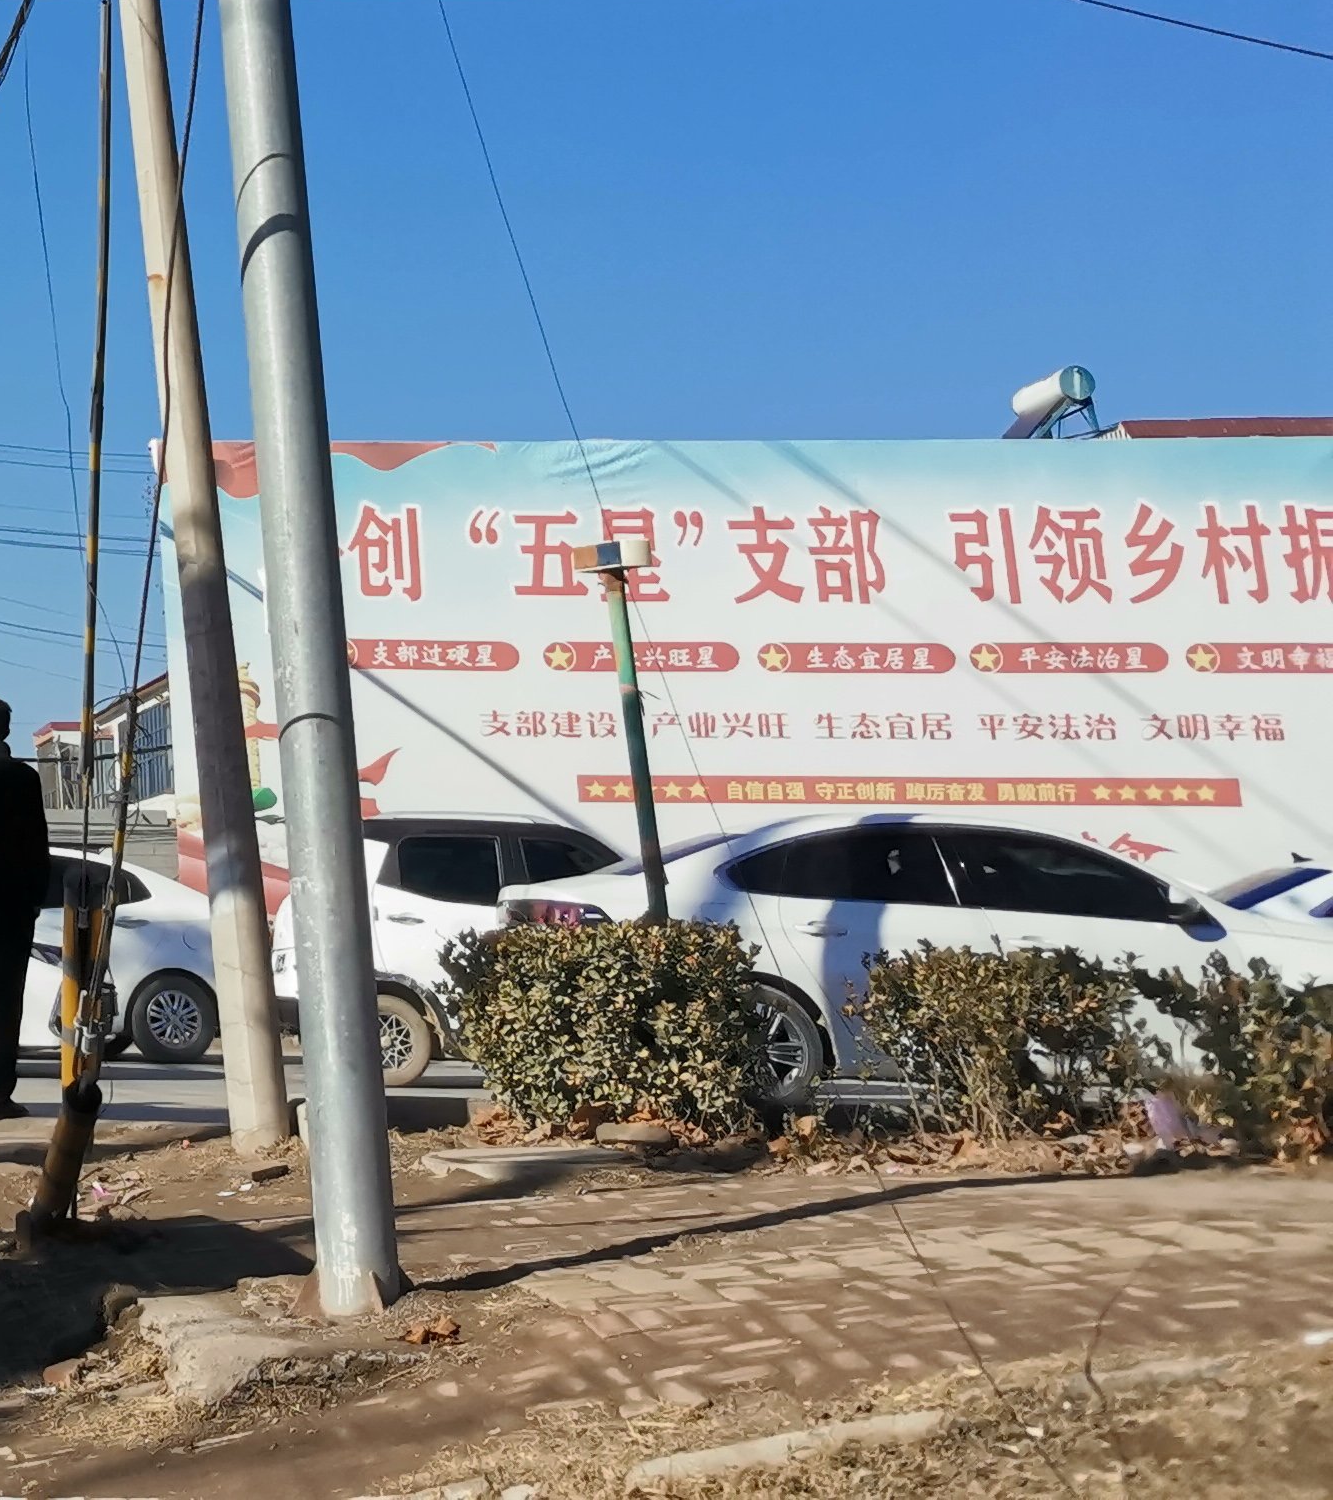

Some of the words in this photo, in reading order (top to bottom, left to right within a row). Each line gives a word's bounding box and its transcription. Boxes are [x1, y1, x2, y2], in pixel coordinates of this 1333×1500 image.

[335, 503, 887, 605] 创“五星”支部
[370, 644, 498, 669] 支部过硬星
[590, 644, 720, 670] 产兴旺星
[805, 645, 935, 671] 生态宜居星
[1017, 646, 1149, 672] 平安法治星
[480, 711, 617, 740] 支部建设
[651, 711, 793, 740] 产业兴旺
[813, 712, 953, 741] 生态宜居
[977, 713, 1118, 742] 平安法治
[1141, 712, 1286, 742] 文明幸福
[726, 781, 806, 801] 自信自强
[815, 781, 896, 802] 守正创新
[905, 782, 986, 802] 踔厉奋发
[997, 783, 1077, 803] 勇毅前行
